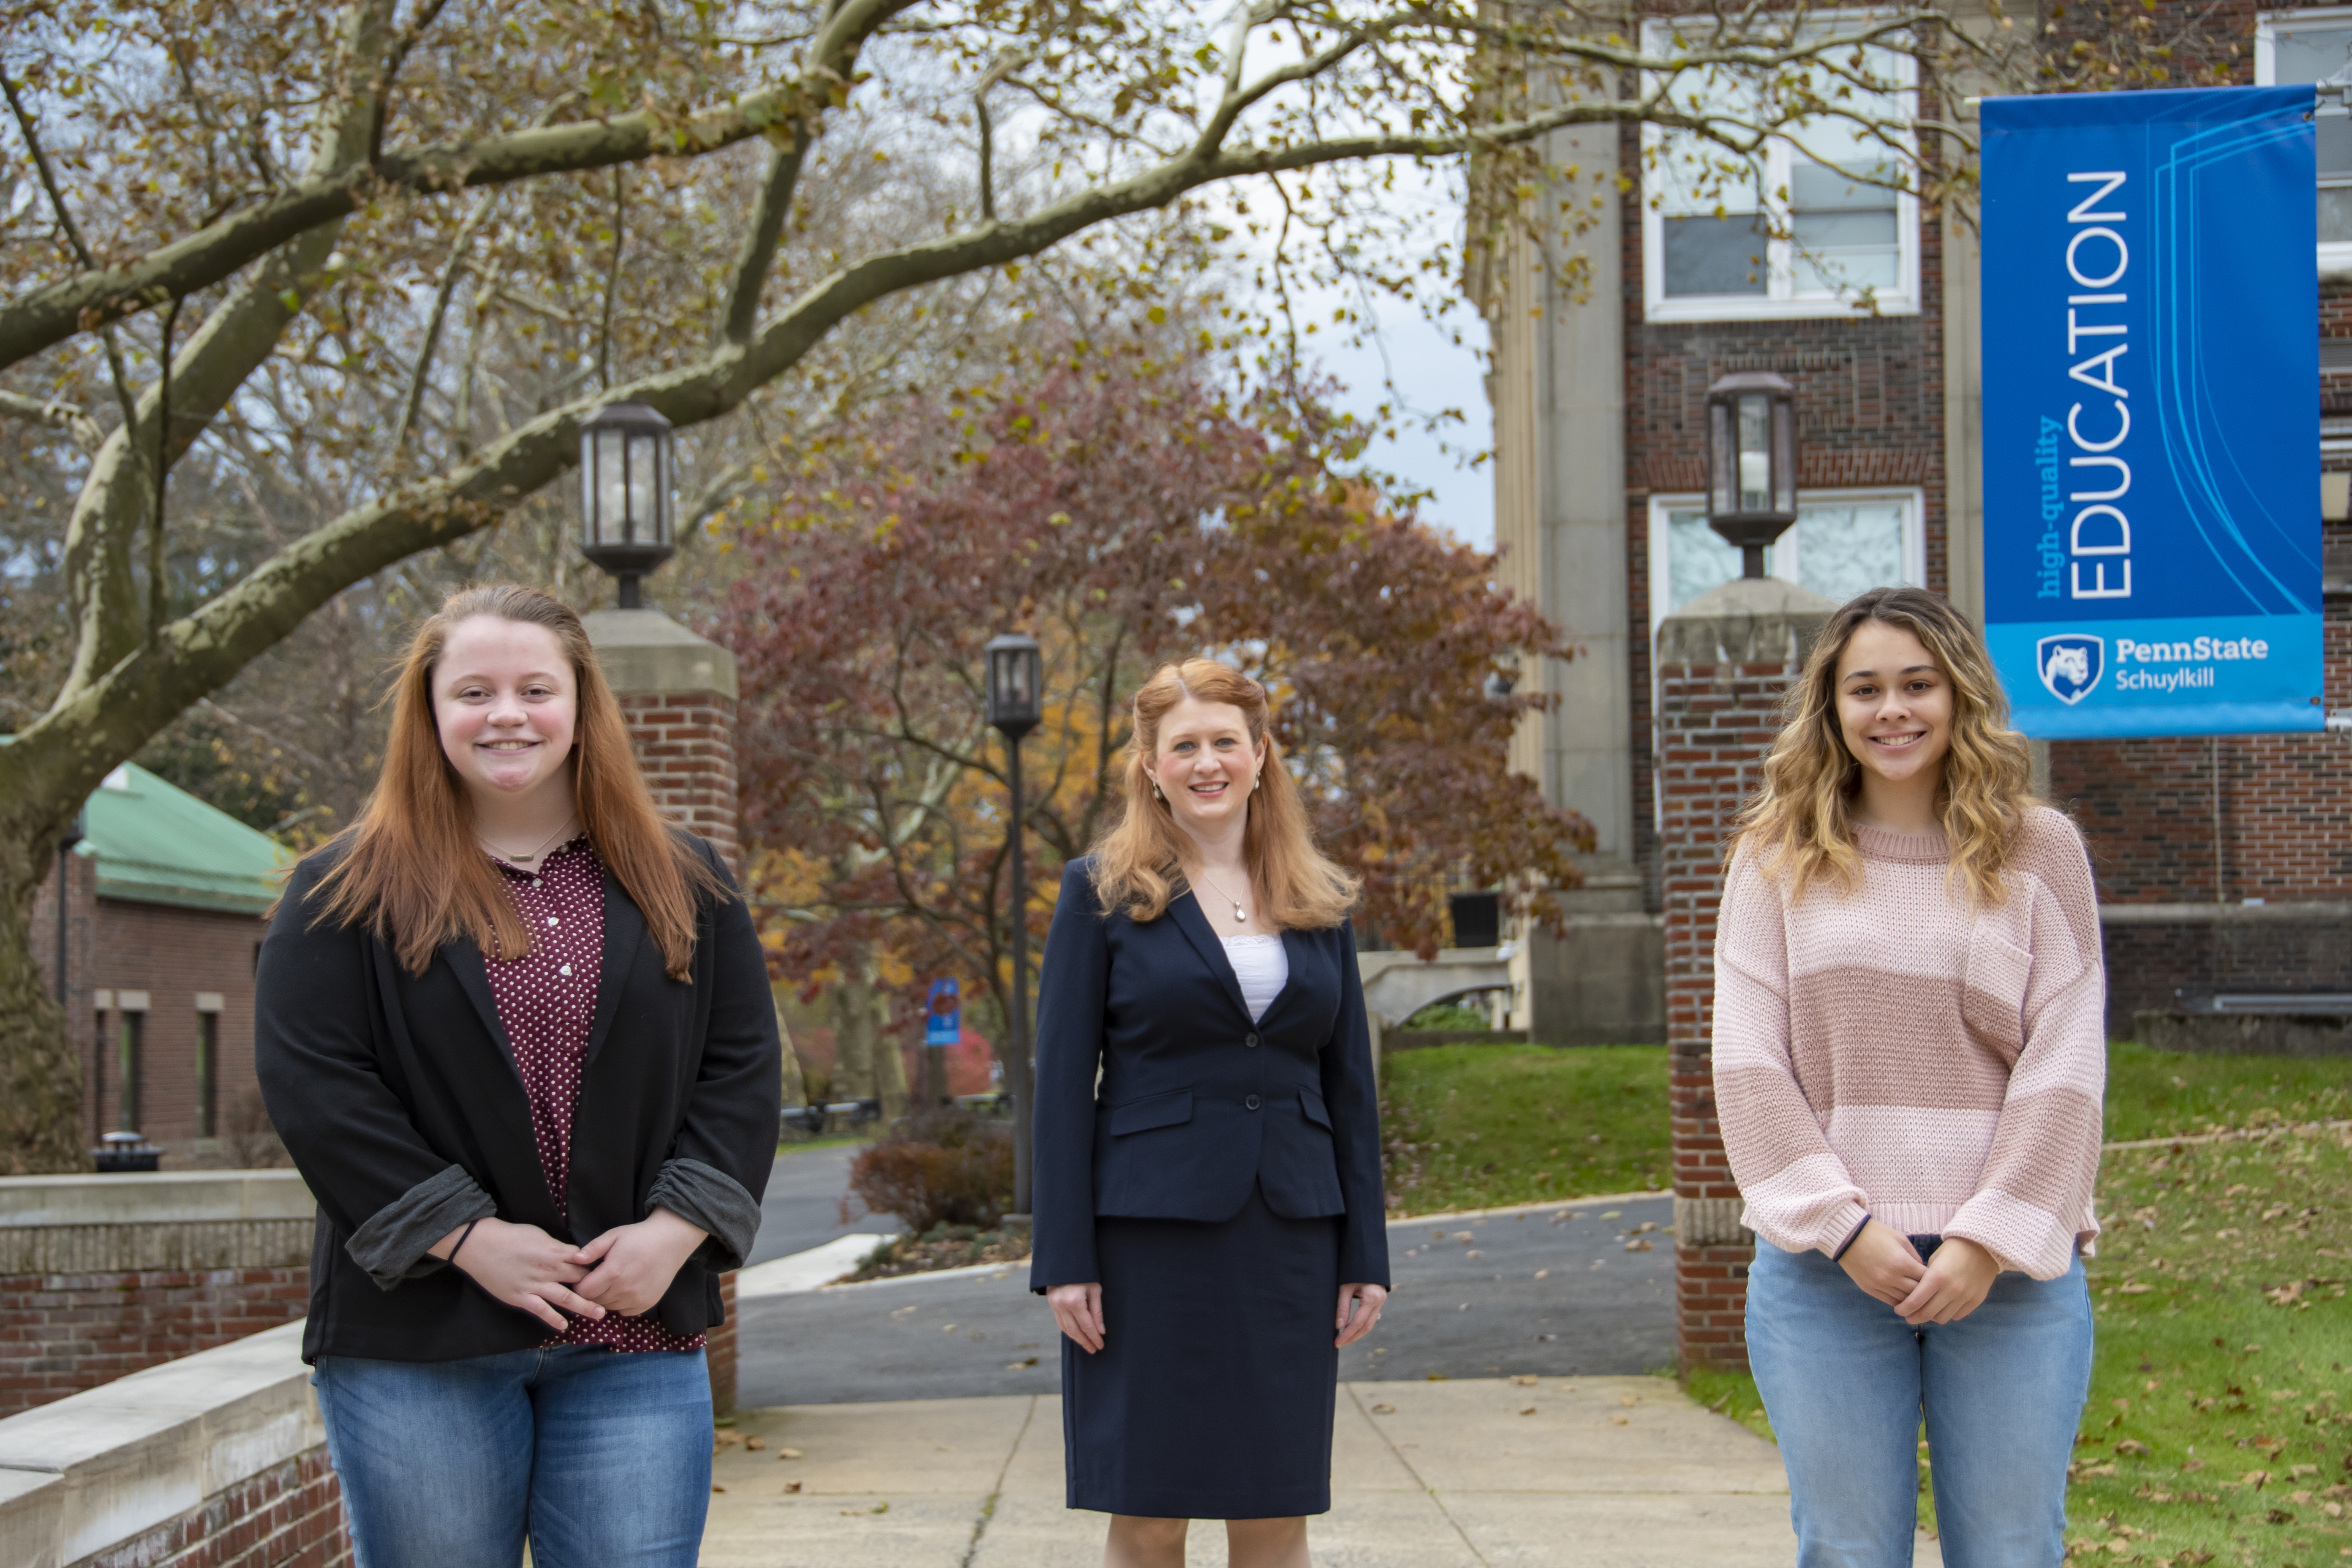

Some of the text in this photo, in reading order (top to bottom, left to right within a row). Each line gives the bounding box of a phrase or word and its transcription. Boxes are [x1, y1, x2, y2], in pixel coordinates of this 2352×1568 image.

[2066, 171, 2131, 599] EDUCATION
[2035, 415, 2065, 599] high-quality
[2115, 636, 2268, 664] PennState
[2115, 667, 2214, 694] Schuylkill
